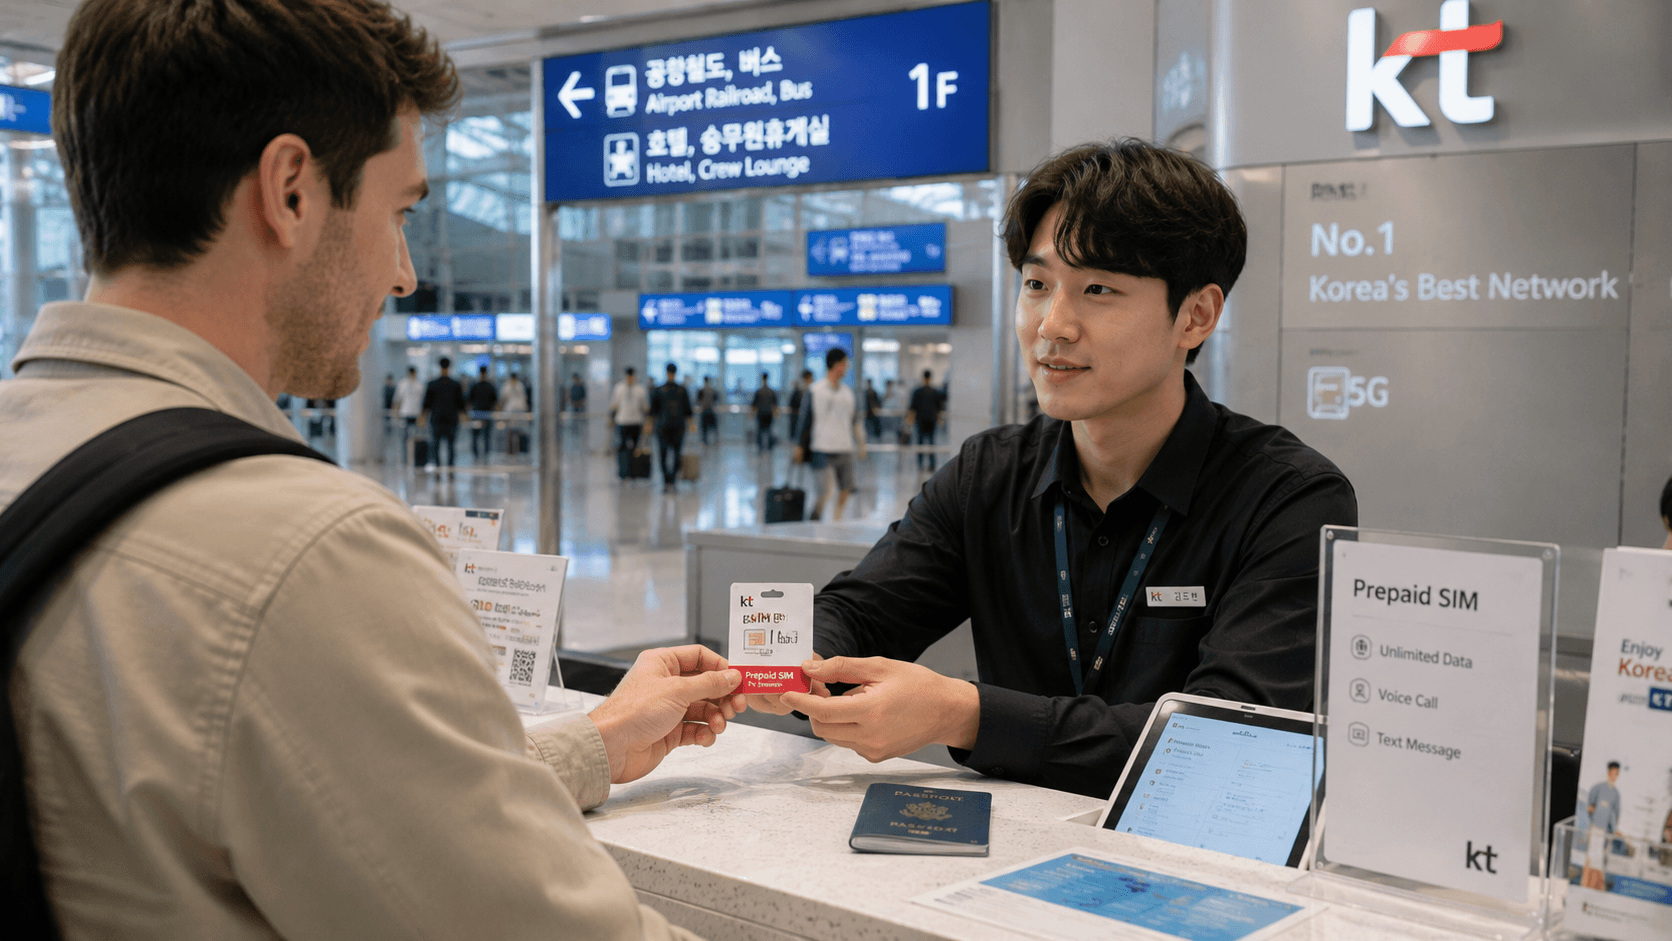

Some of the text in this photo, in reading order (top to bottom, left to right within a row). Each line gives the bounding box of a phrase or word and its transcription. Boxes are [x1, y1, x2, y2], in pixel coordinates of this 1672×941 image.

[738, 46, 783, 77] 버스
[1346, 0, 1503, 132] kt
[645, 79, 813, 116] Airport Railroad, Bus
[646, 155, 810, 184] Hotel, Crew Lounge
[1311, 221, 1394, 257] No.1
[1309, 270, 1619, 302] Korea's Best Network
[1348, 376, 1389, 408] 5G
[740, 596, 753, 607] kt
[1353, 579, 1478, 611] Prepaid SIM
[1380, 644, 1473, 669] Unlimited Data
[1621, 639, 1662, 660] Enjoy
[745, 671, 794, 680] Prepaid SIM
[1378, 688, 1438, 709] Voice Call
[1377, 732, 1461, 760] Text Message
[1465, 841, 1498, 875] kt
